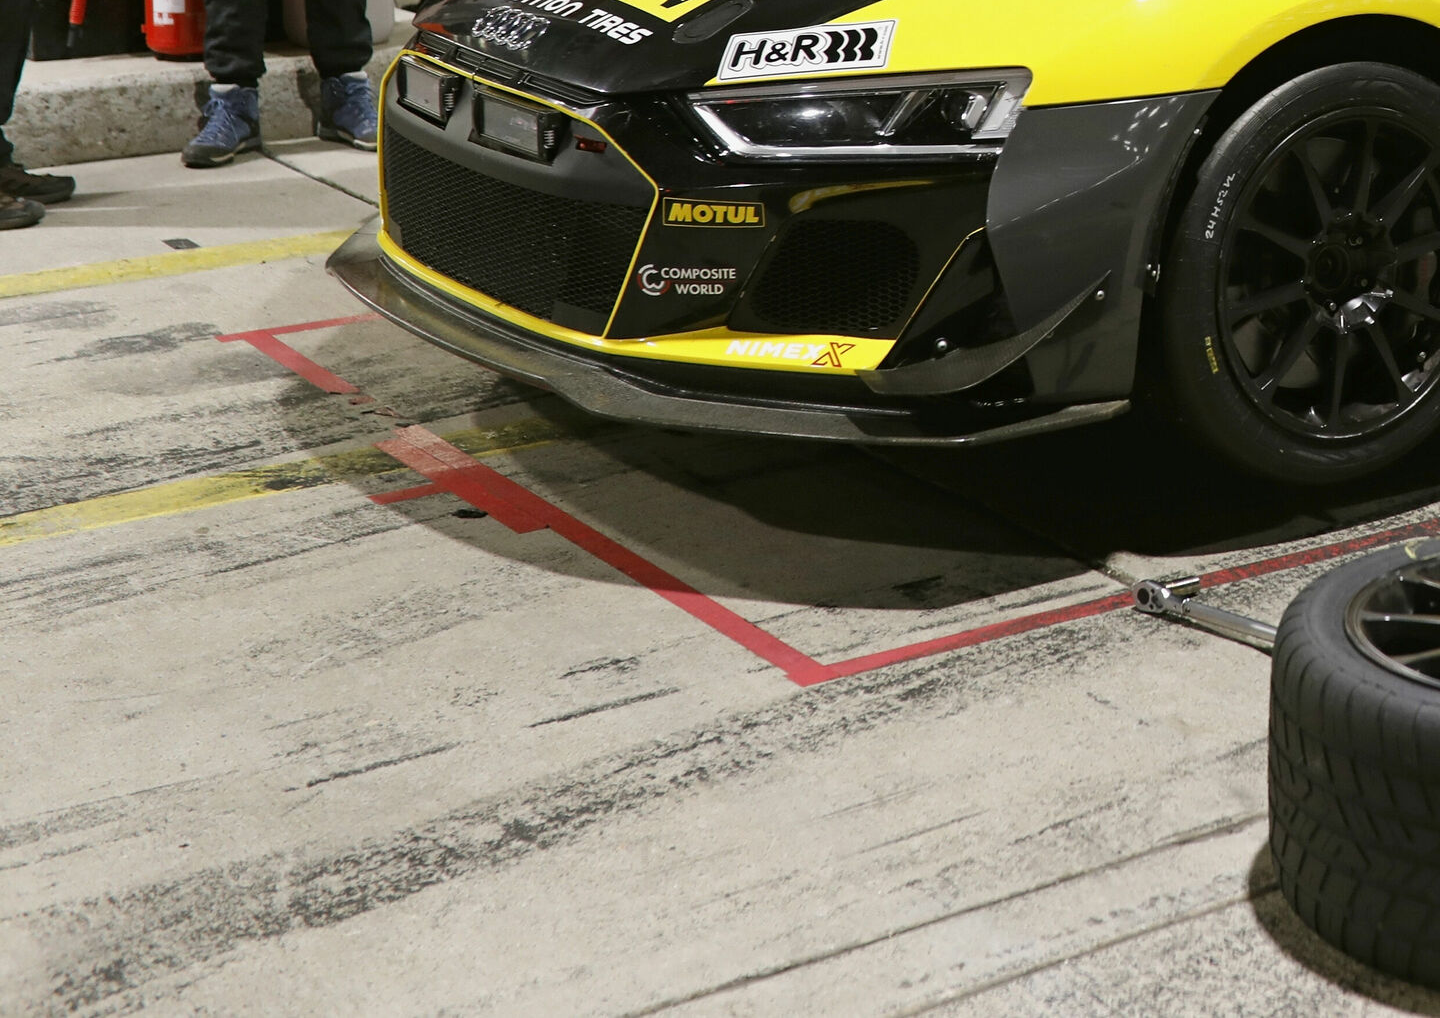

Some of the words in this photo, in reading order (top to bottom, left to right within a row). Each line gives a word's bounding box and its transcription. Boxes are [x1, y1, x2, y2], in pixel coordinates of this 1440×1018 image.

[577, 8, 653, 46] TIRES
[731, 34, 820, 68] H&R
[668, 202, 760, 224] MOTUL
[661, 267, 737, 280] COMPOSITE
[675, 283, 724, 296] WORLD
